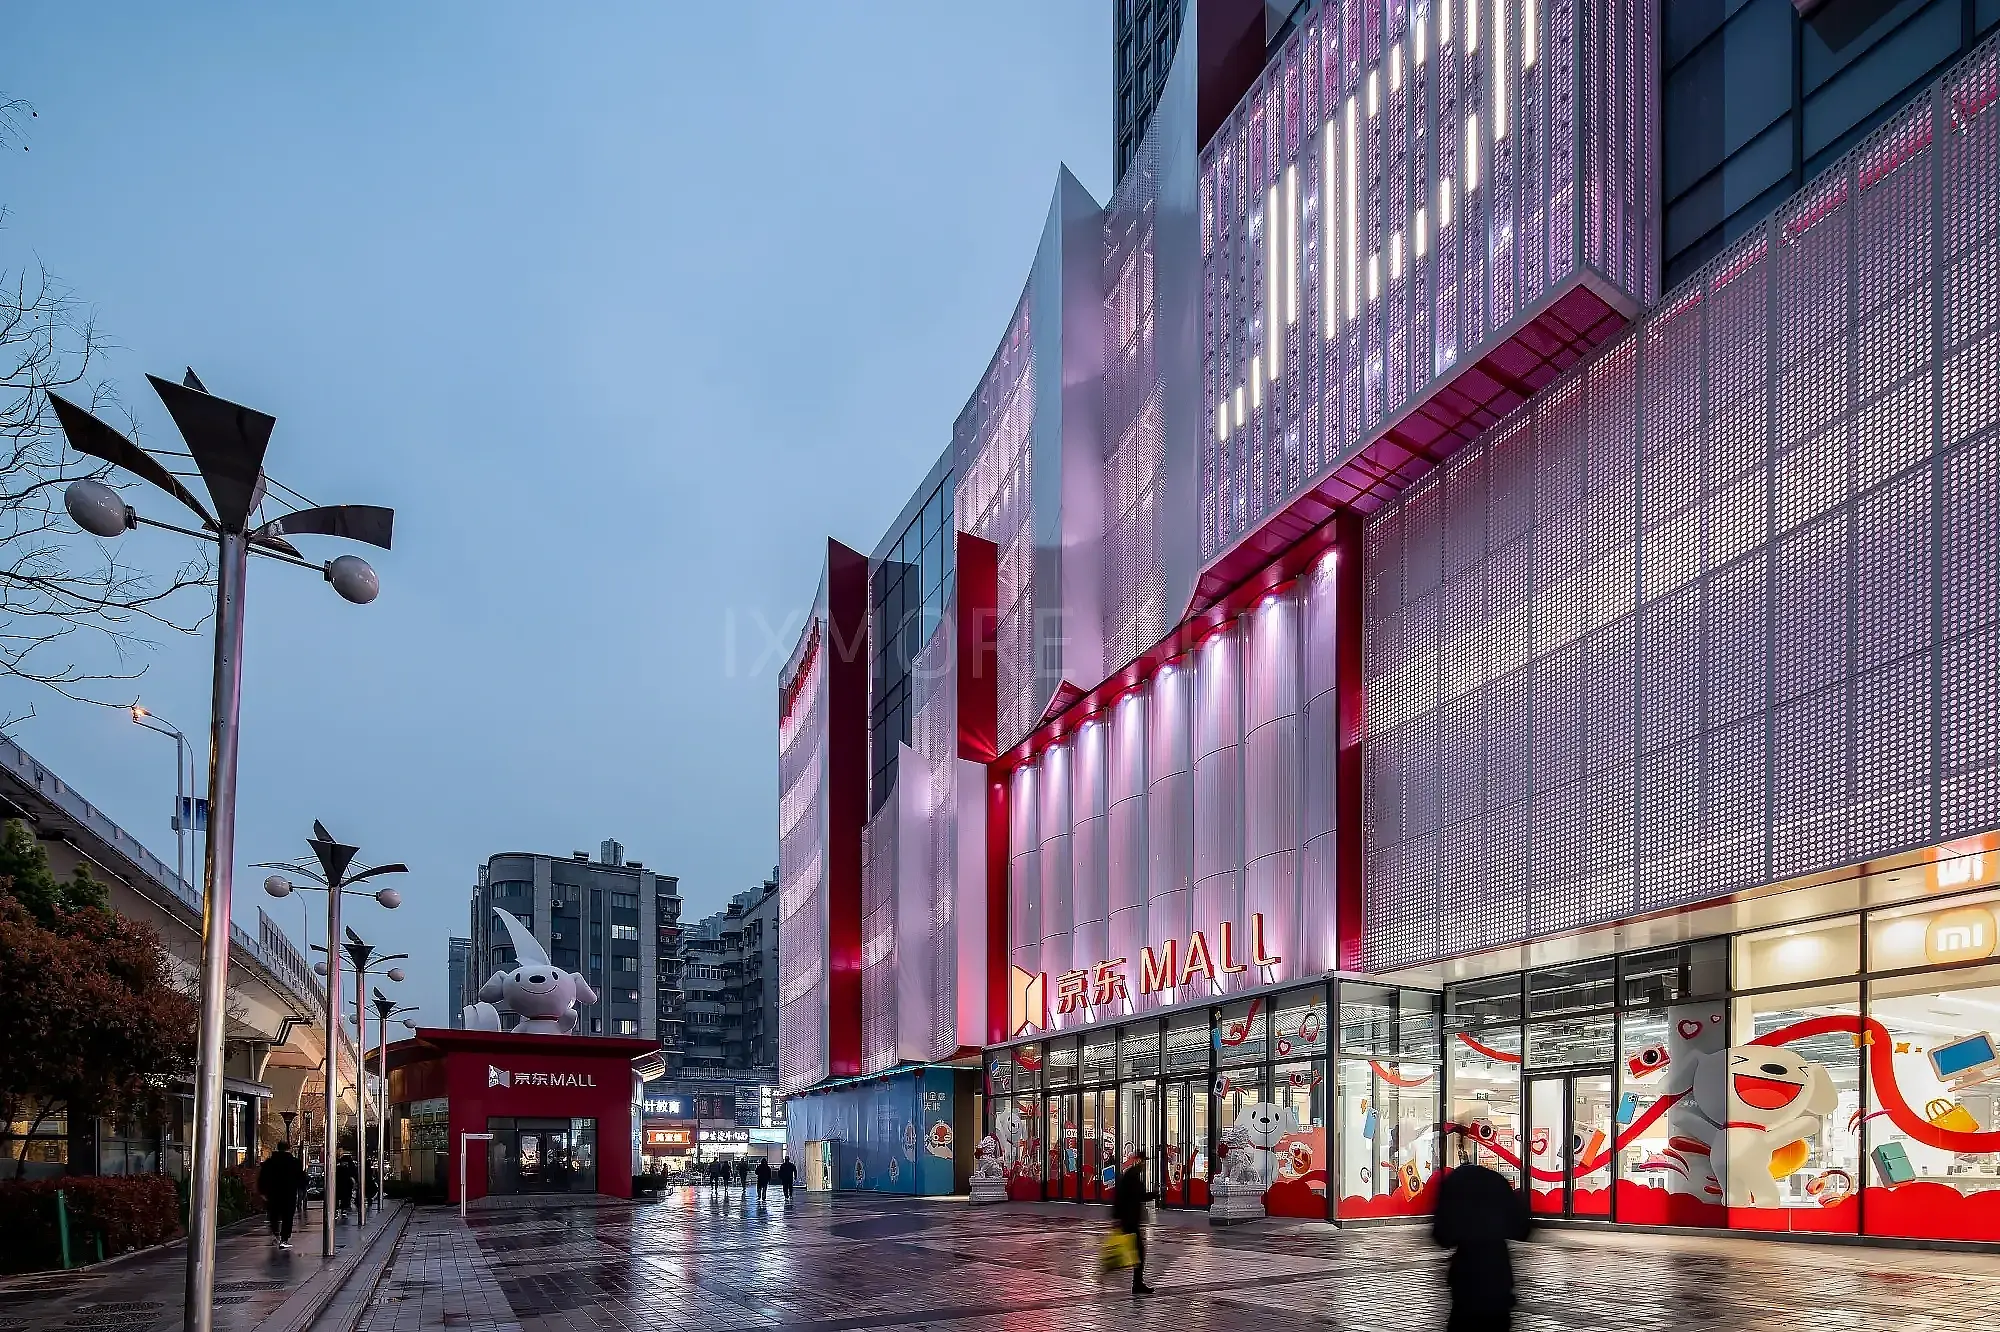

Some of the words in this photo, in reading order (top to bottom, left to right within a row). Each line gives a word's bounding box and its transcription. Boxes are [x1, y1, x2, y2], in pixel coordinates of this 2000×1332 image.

[1056, 956, 1128, 1015] 京东
[1140, 912, 1282, 995] MALL
[1937, 922, 1983, 952] mi
